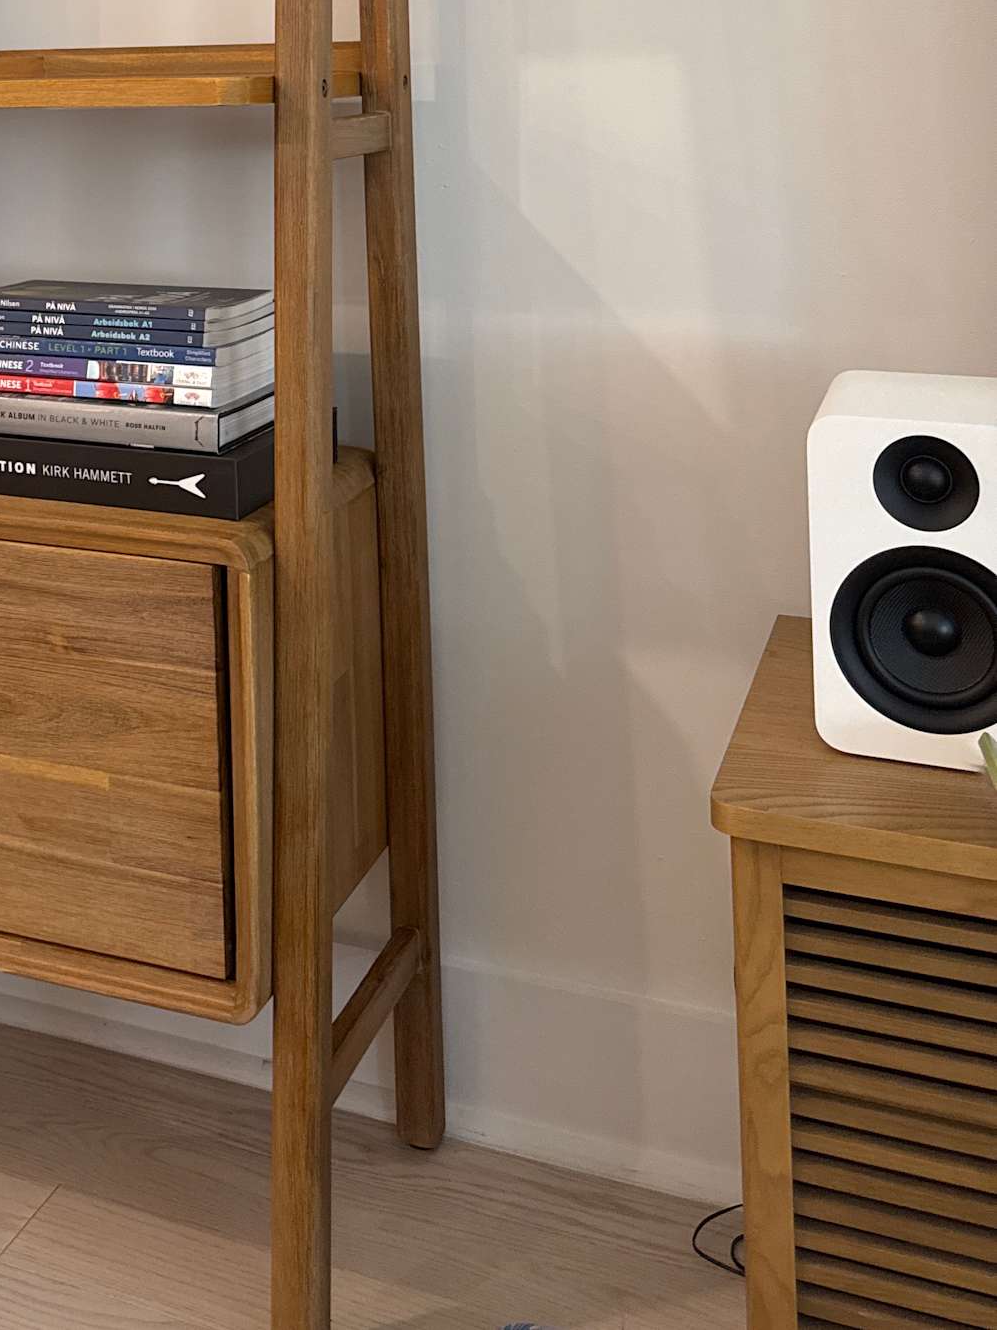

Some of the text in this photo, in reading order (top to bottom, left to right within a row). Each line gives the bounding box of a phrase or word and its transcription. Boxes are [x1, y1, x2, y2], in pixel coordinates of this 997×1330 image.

[0, 299, 20, 307] Nilsen
[46, 300, 56, 311] PÅ
[57, 301, 76, 312] NIVÅ
[31, 313, 43, 324] PÅ
[44, 315, 65, 325] NIVÅ
[93, 318, 139, 328] Arbeidsbok
[141, 320, 153, 328] A1
[30, 325, 42, 335] PÅ
[43, 326, 64, 336] NIVÅ
[91, 330, 136, 341] Arbeidsbok
[138, 333, 151, 341] A2
[48, 342, 77, 352] LEVEL
[94, 345, 120, 355] PART
[122, 346, 127, 355] 1
[137, 347, 175, 358] Textbook
[25, 359, 34, 373] 2
[40, 361, 64, 369] Textbook
[24, 379, 32, 392] 1
[8, 412, 35, 421] ALBUM
[37, 413, 46, 421] IN
[49, 414, 79, 425] BLACK
[81, 416, 87, 425] &
[90, 418, 120, 428] WHITE
[144, 423, 166, 431] HALFIN
[42, 464, 70, 479] KIRK
[73, 468, 132, 484] HAMMETT
